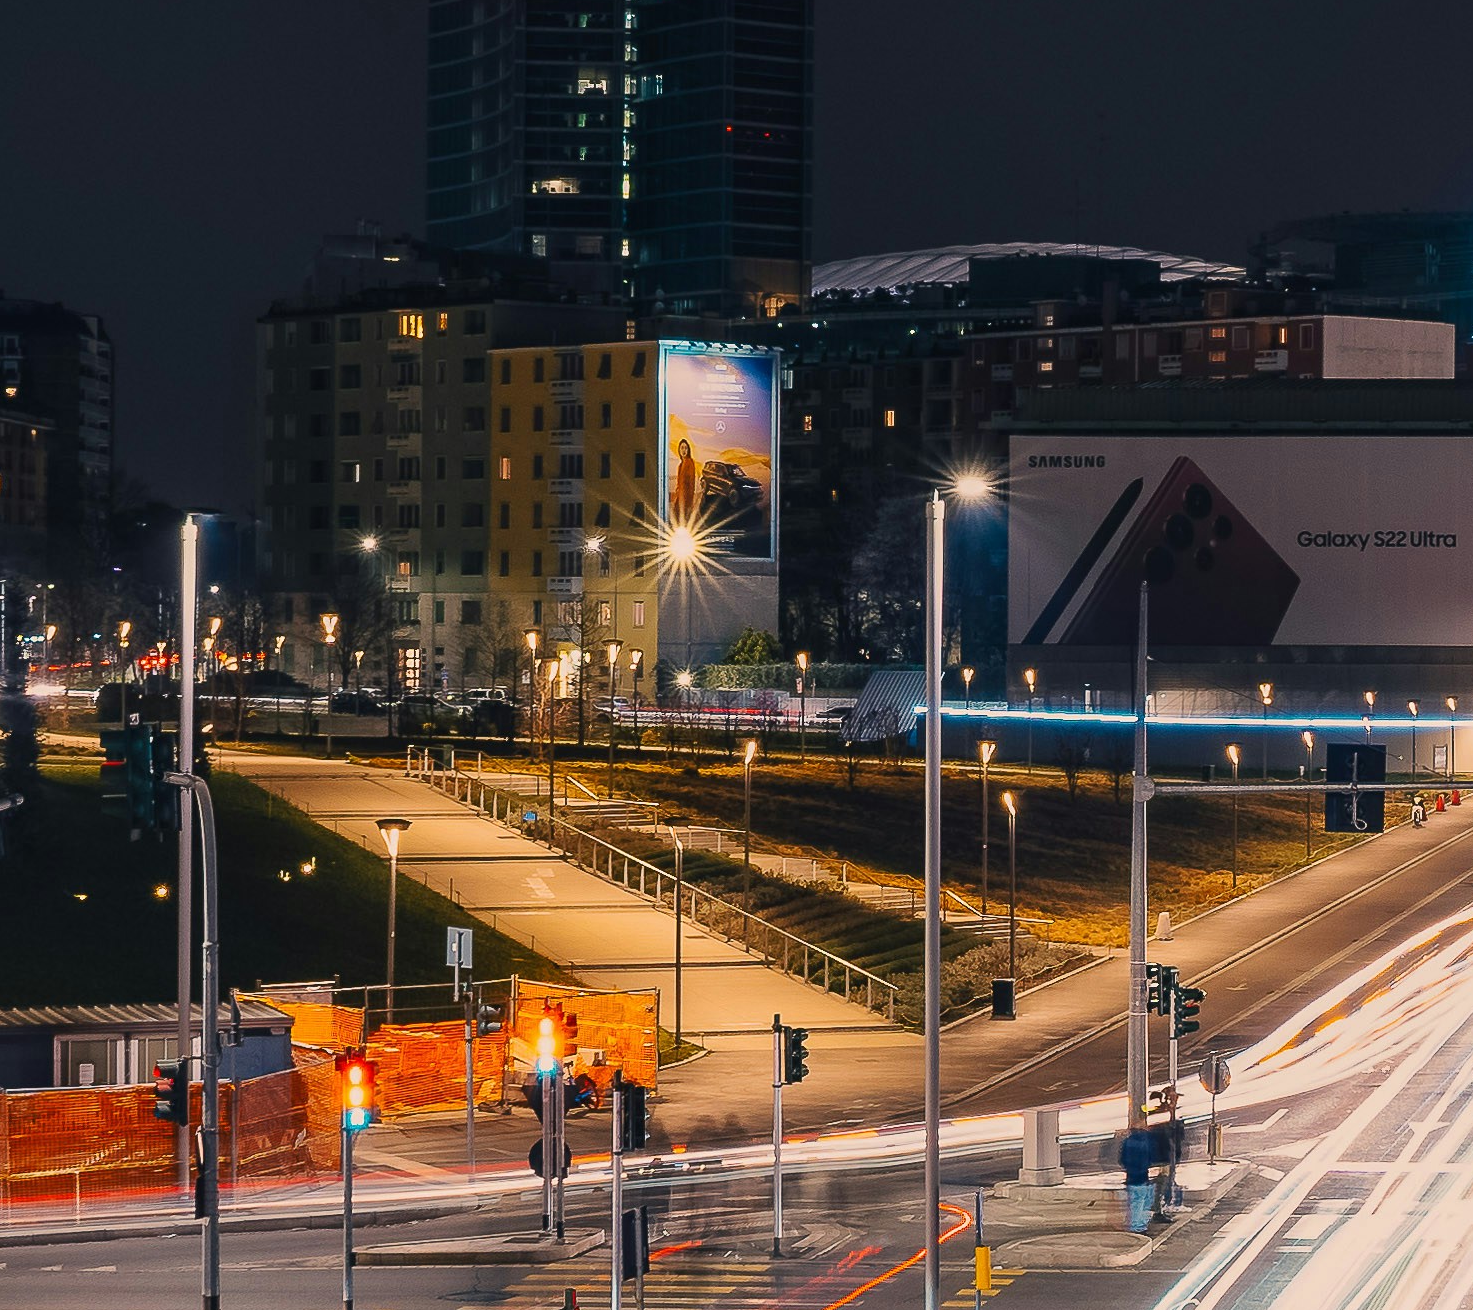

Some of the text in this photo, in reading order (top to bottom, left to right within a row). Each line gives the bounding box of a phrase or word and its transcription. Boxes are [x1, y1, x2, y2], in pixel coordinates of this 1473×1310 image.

[1028, 455, 1106, 468] SAMSUNG
[1297, 530, 1457, 551] Galaxy S22 Ultra
